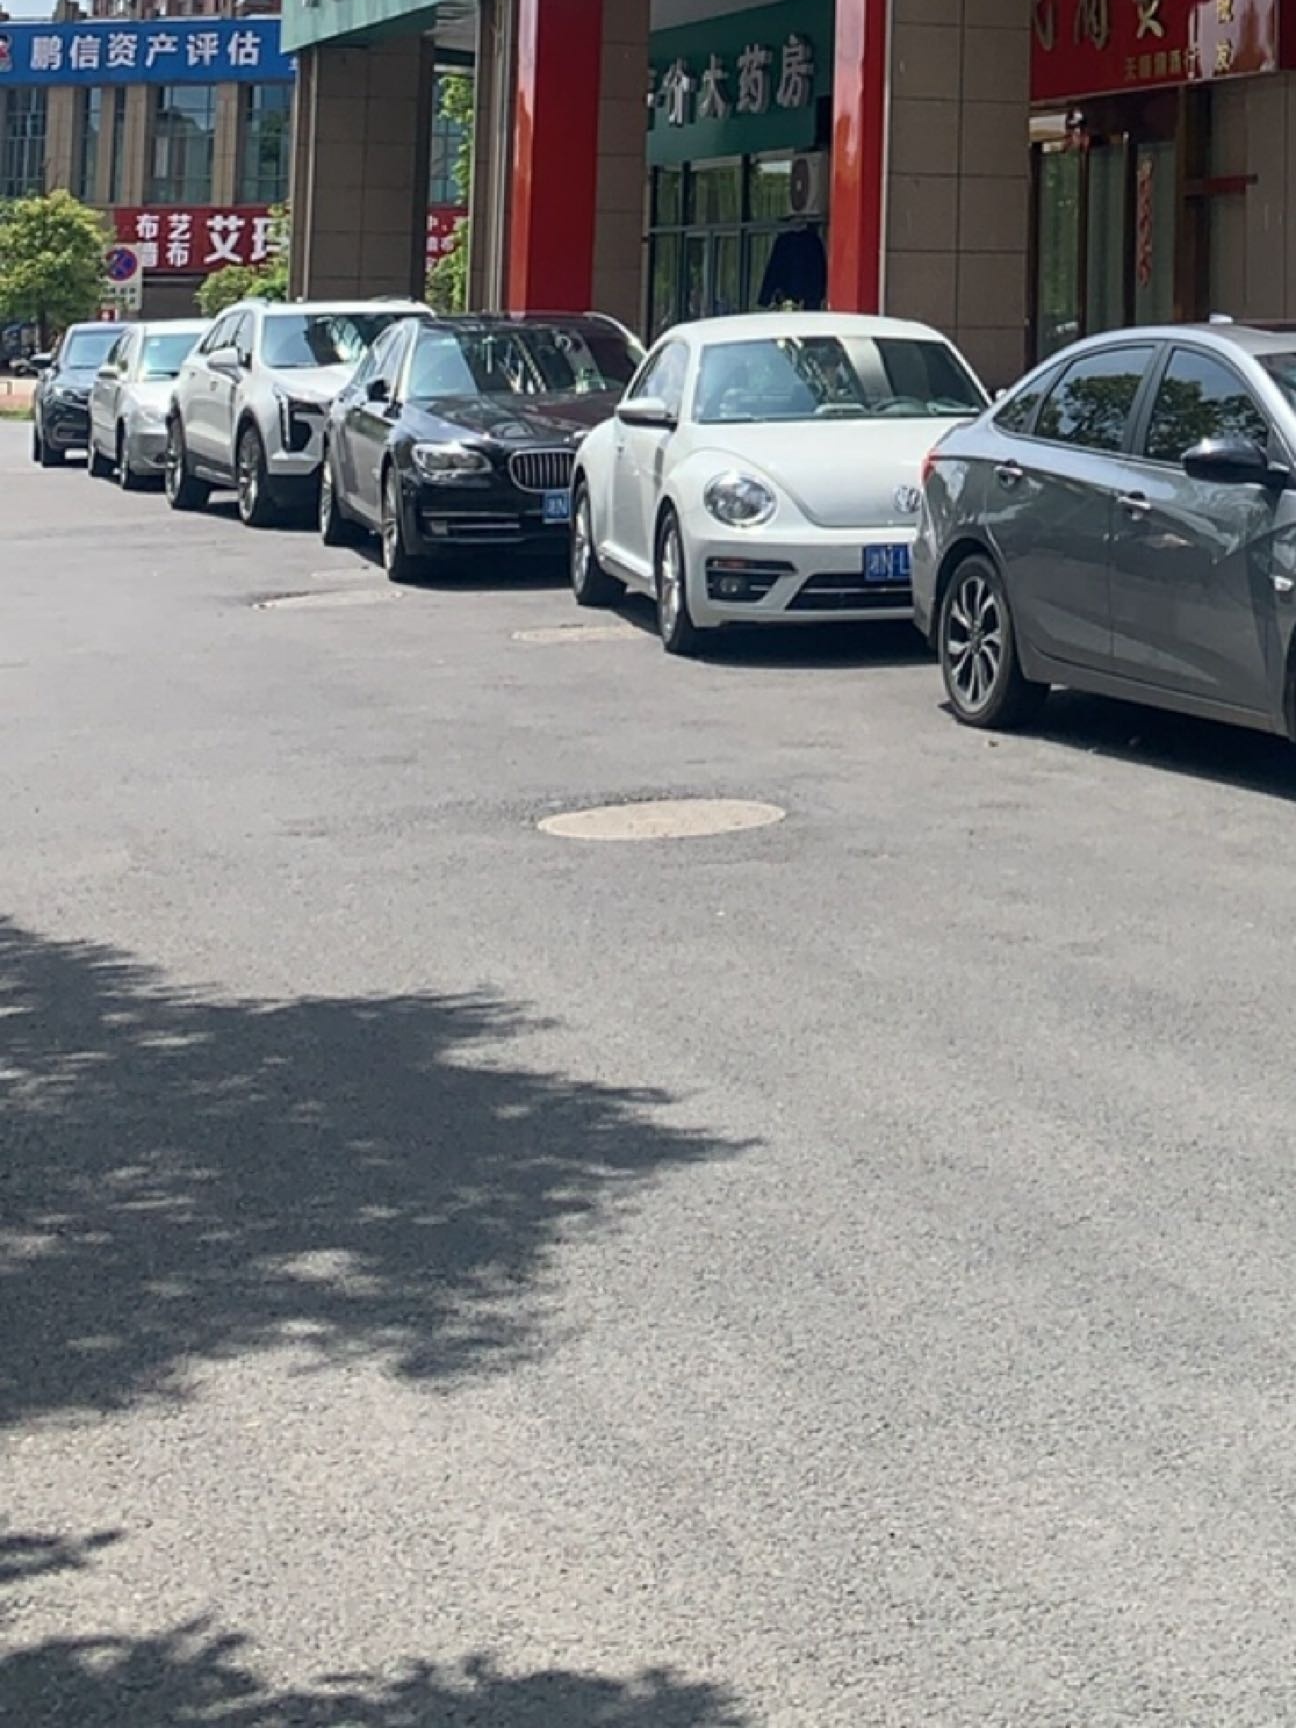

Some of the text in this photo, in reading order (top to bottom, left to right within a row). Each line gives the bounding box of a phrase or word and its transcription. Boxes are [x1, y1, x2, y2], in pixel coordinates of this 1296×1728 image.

[30, 31, 261, 71] 鹏信资产评估
[136, 213, 192, 240] 布艺
